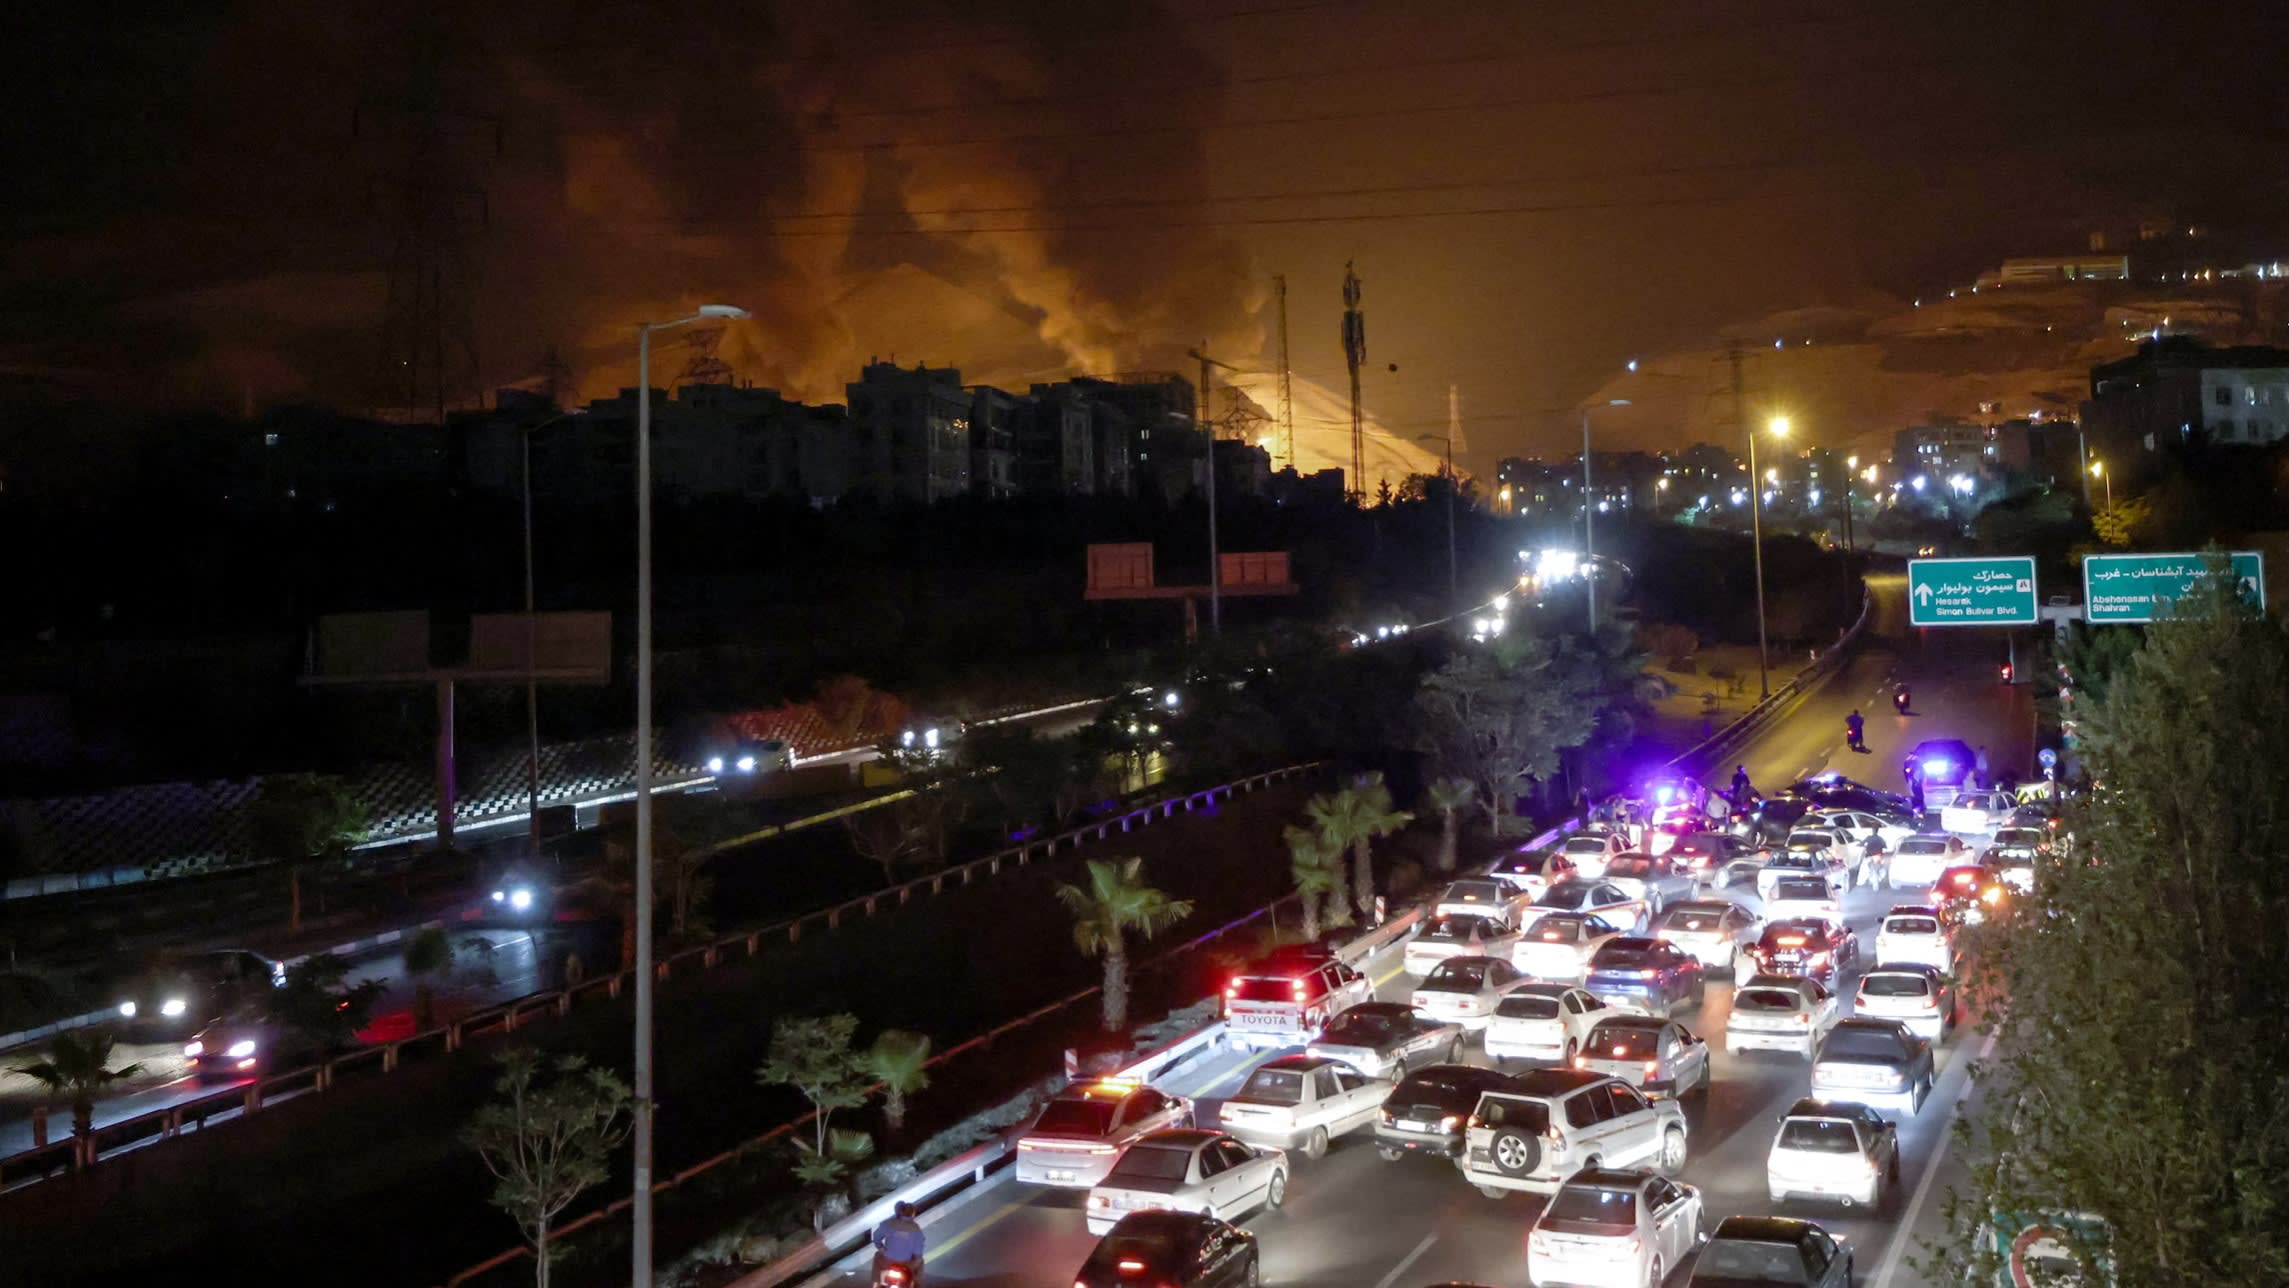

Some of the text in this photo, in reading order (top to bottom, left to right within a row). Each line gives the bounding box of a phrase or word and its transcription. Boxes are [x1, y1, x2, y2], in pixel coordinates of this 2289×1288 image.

[1972, 570, 2013, 582] حصارک
[2094, 567, 2121, 580] غرب
[2131, 565, 2184, 579] آبشناسان
[1936, 582, 2013, 595] سیمون بولیوار
[1935, 597, 1972, 606] Hesarak
[1936, 607, 1963, 616] Simon
[2092, 604, 2131, 612] Shahran
[1241, 1014, 1288, 1025] TOYOTA
